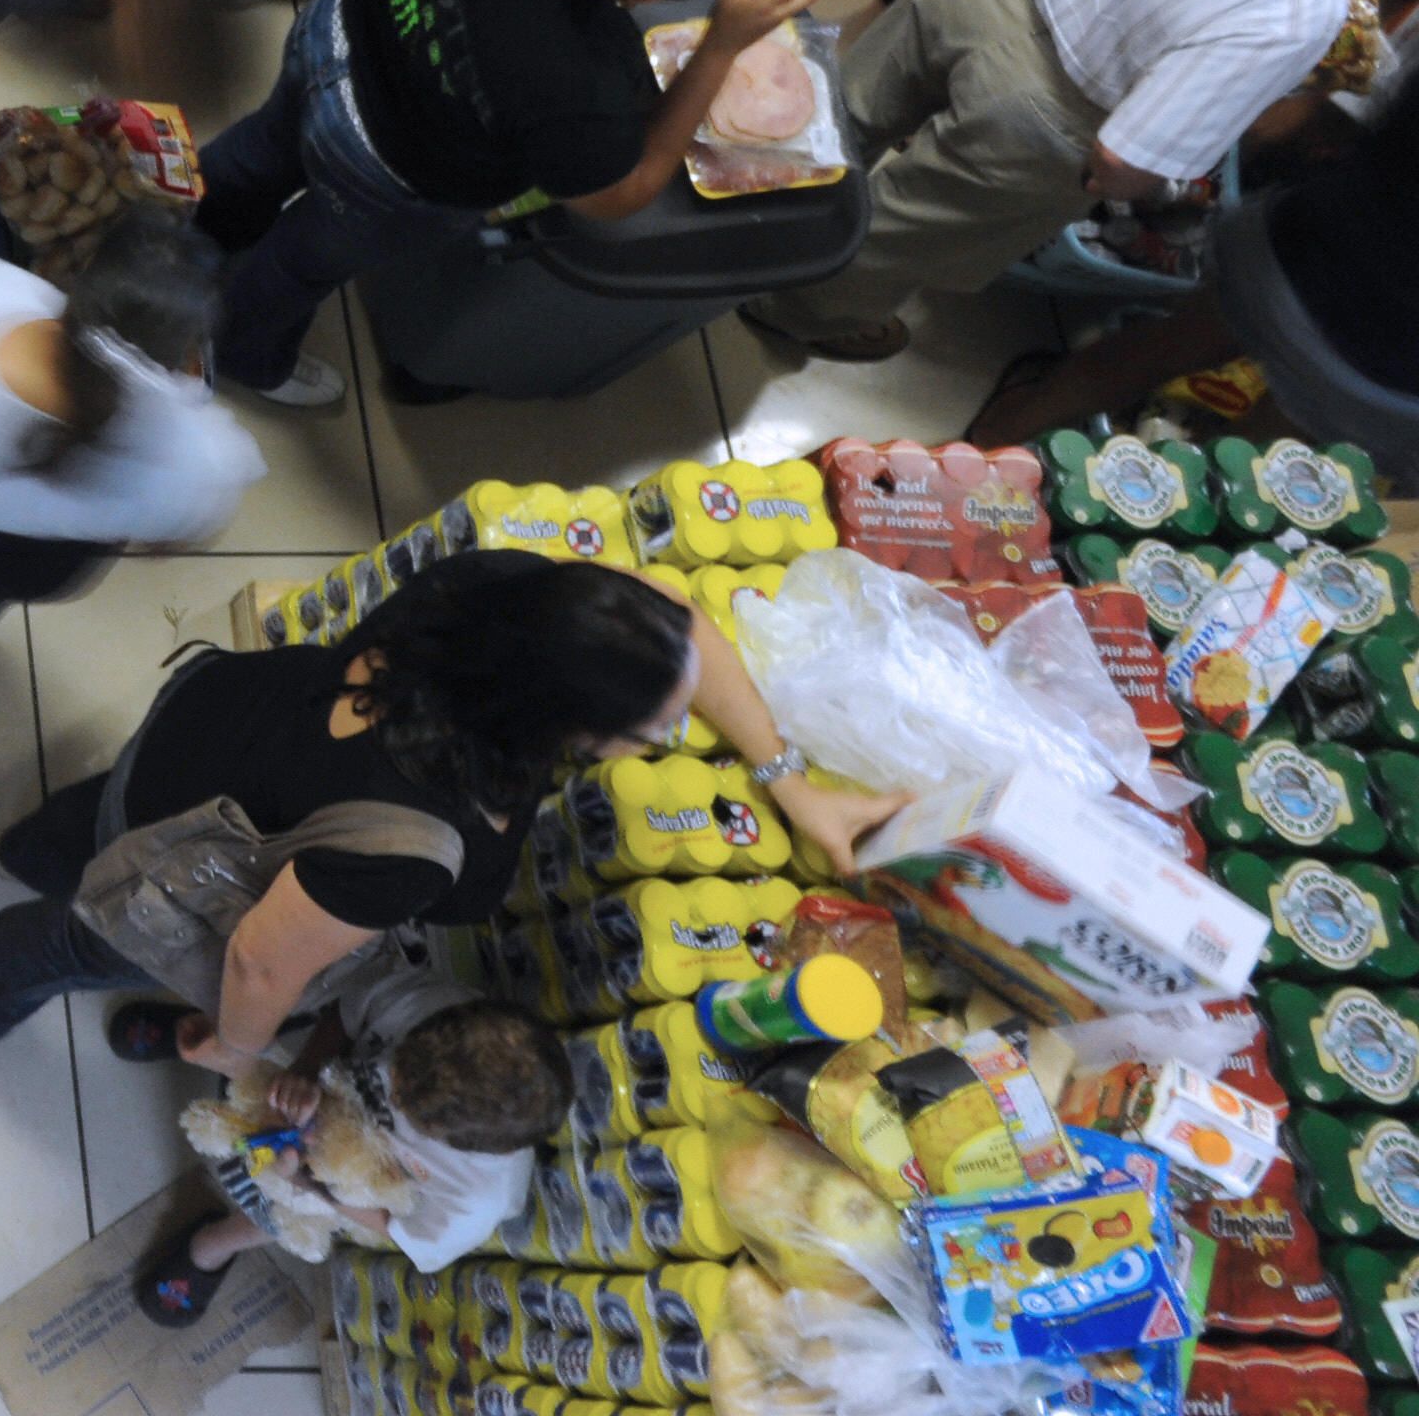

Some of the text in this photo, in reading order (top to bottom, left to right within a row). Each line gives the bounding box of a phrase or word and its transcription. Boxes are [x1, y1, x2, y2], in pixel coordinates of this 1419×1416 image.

[963, 497, 1038, 528] Imperial
[1209, 1207, 1295, 1248] Imperial
[1020, 1248, 1148, 1316] OREO
